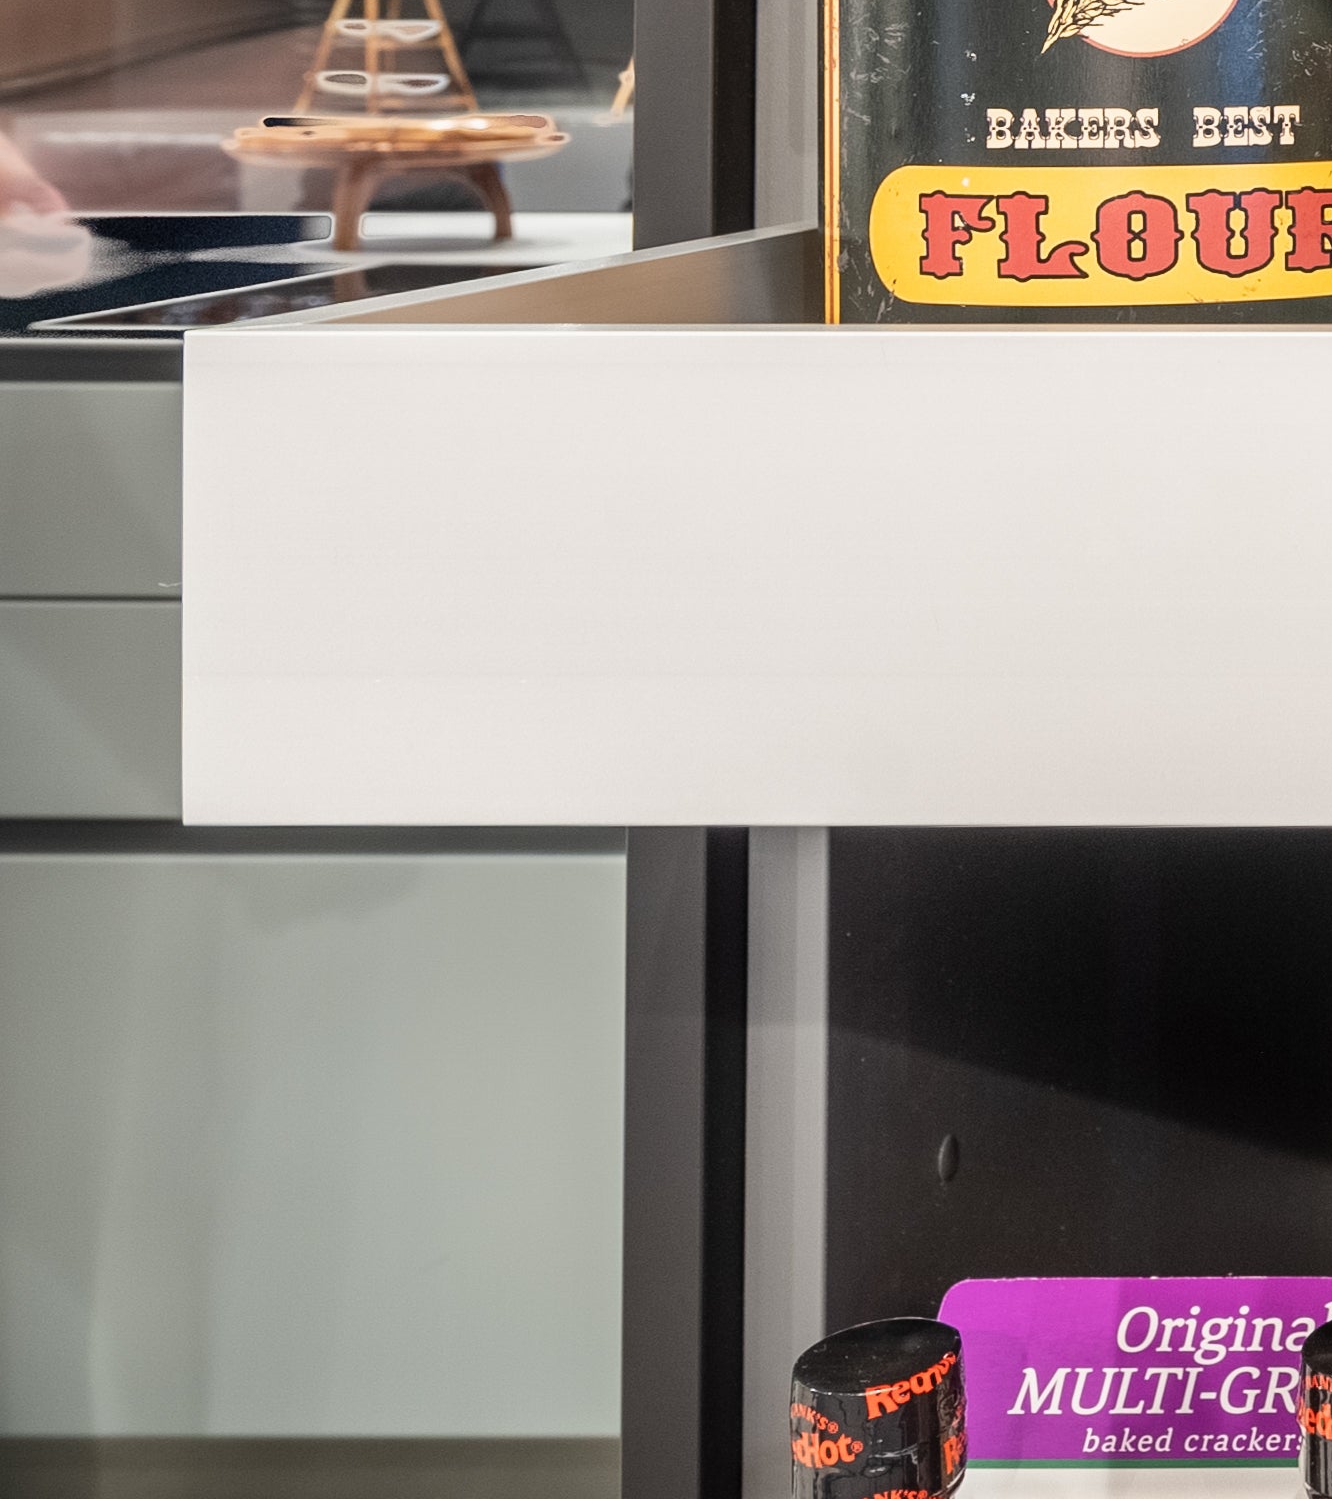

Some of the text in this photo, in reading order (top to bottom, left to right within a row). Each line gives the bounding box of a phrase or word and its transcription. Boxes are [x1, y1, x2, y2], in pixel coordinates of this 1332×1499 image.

[986, 104, 1300, 149] BAKERS BEST
[1082, 1427, 1172, 1454] baked
